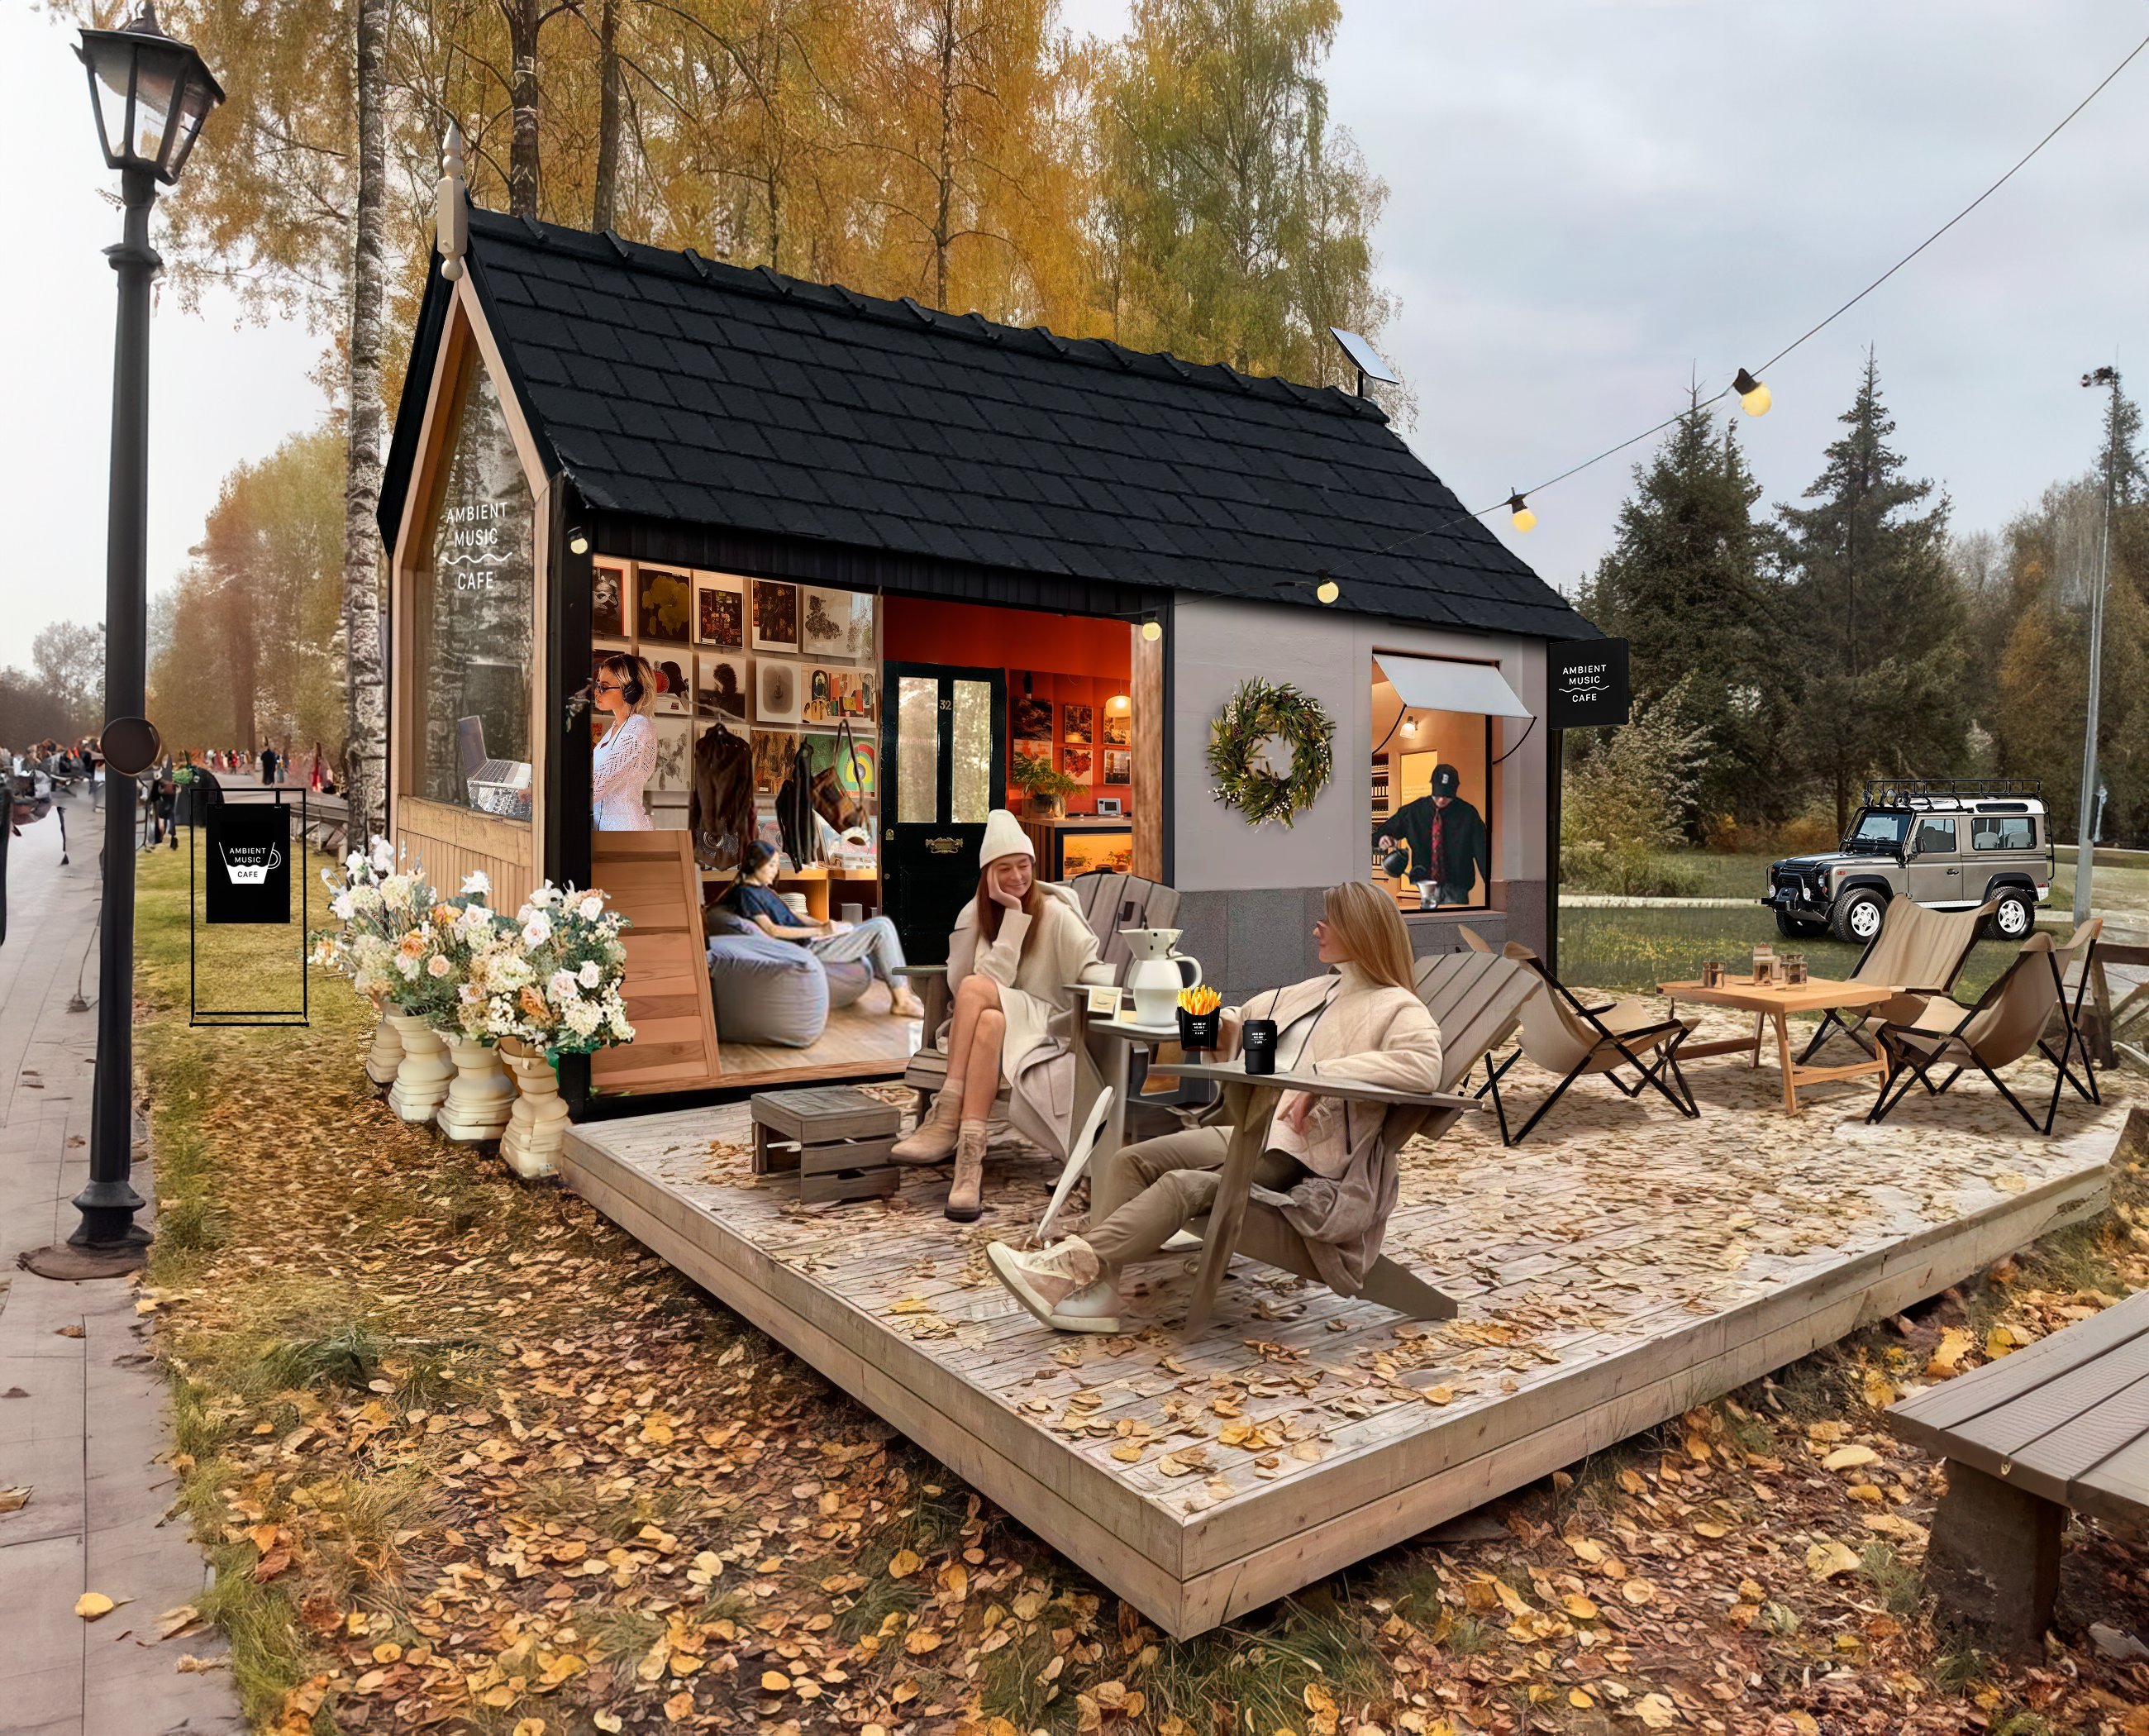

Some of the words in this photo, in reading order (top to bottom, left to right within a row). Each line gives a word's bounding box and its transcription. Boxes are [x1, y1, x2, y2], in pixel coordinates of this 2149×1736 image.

[446, 502, 507, 523] AMBIENT
[455, 528, 498, 547] MUSIC
[458, 571, 493, 590] CAFE
[1562, 664, 1607, 675] AMBIENT
[1569, 675, 1600, 685] MUSIC
[1572, 694, 1597, 703] CAFE
[939, 699, 952, 711] 32
